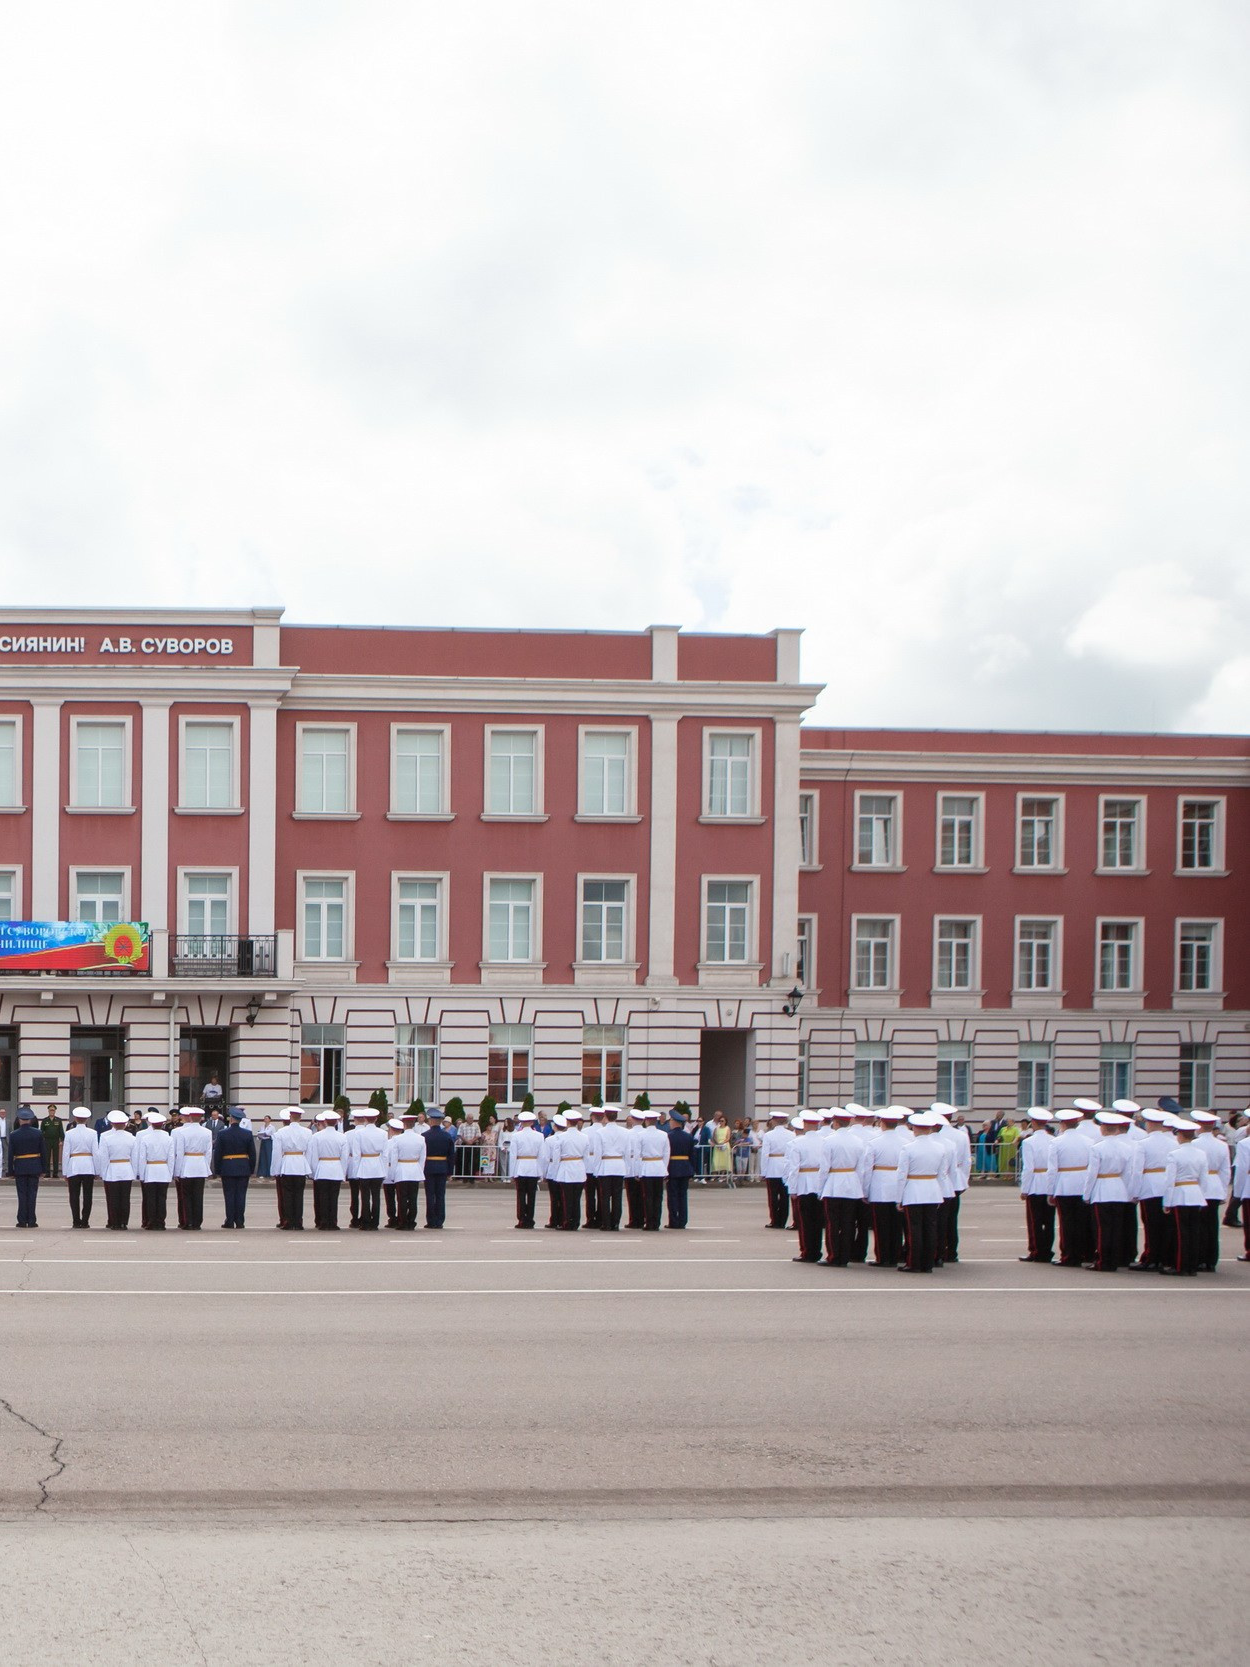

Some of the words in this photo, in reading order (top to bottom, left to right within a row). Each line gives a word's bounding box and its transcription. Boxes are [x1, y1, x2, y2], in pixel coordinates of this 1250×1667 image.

[100, 637, 136, 653] А.В.
[141, 638, 233, 654] СУВОРОВ
[7, 926, 96, 937] СУВОРОВКОМ
